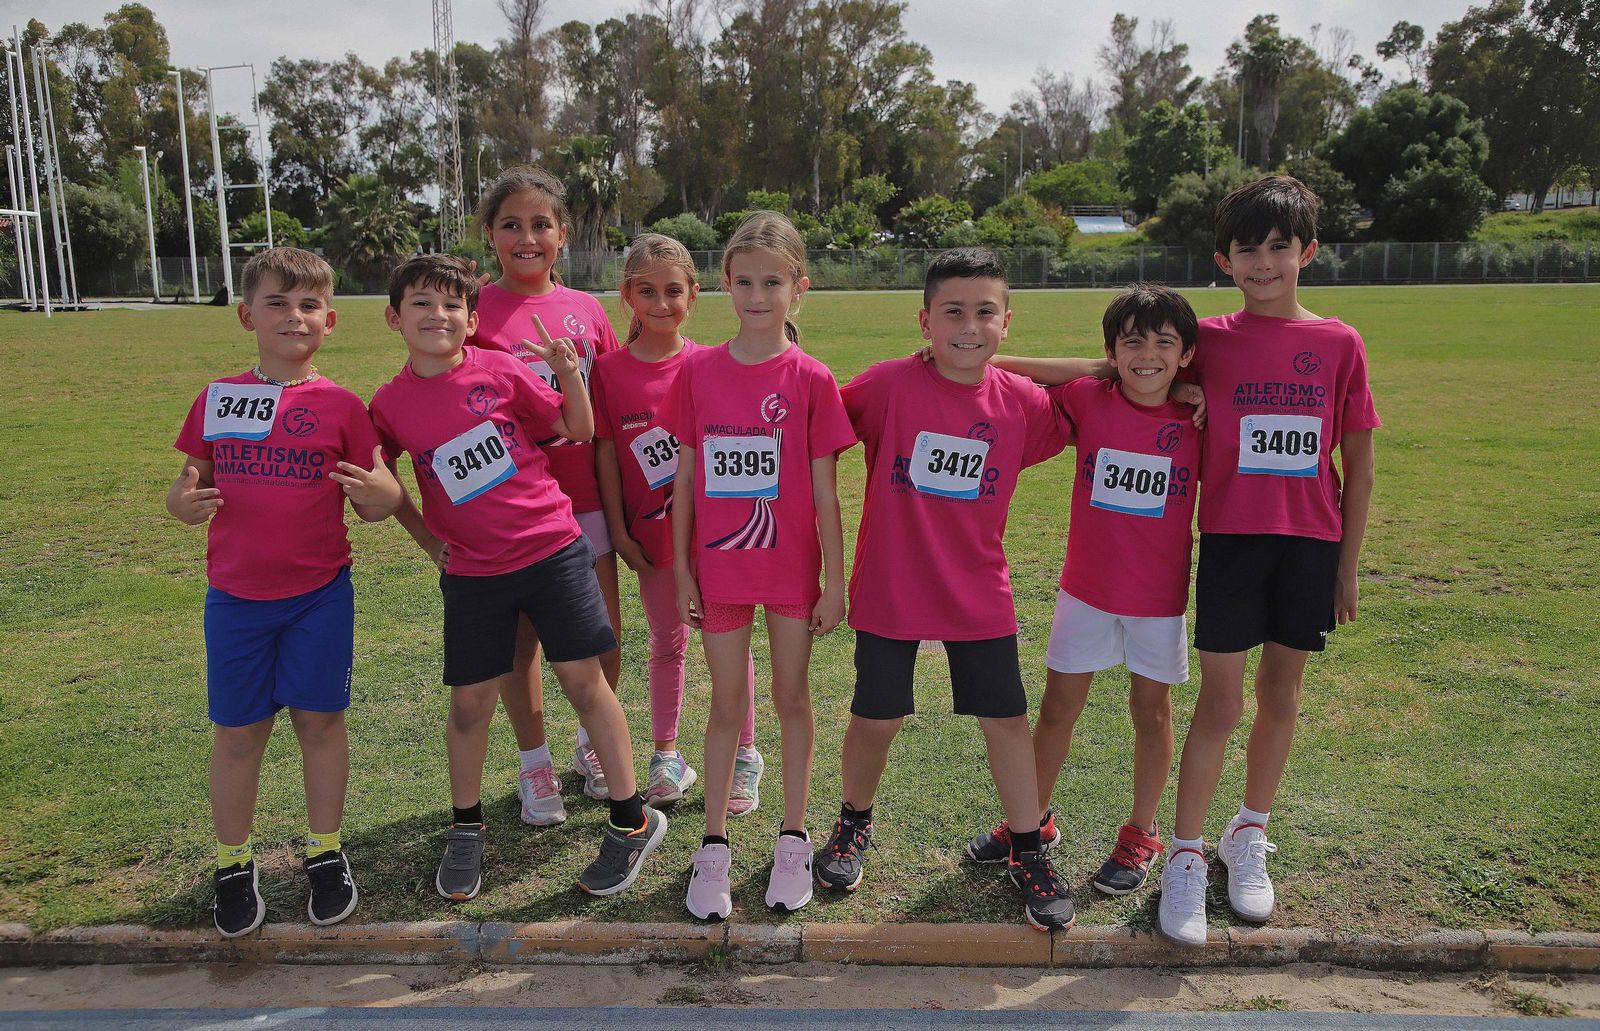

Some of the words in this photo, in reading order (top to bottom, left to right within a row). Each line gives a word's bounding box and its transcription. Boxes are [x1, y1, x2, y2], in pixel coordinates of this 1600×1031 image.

[1232, 395, 1326, 409] INMACULADA
[1234, 382, 1326, 398] ATLETISMO
[217, 396, 276, 421] 3413
[215, 444, 325, 467] ATLETISMO
[643, 433, 680, 468] 339
[1251, 429, 1318, 456] 3409
[215, 461, 323, 480] INMACULADA
[447, 435, 506, 480] 3410
[713, 450, 775, 477] 3395
[927, 448, 983, 479] 3412
[1103, 464, 1167, 496] 3408
